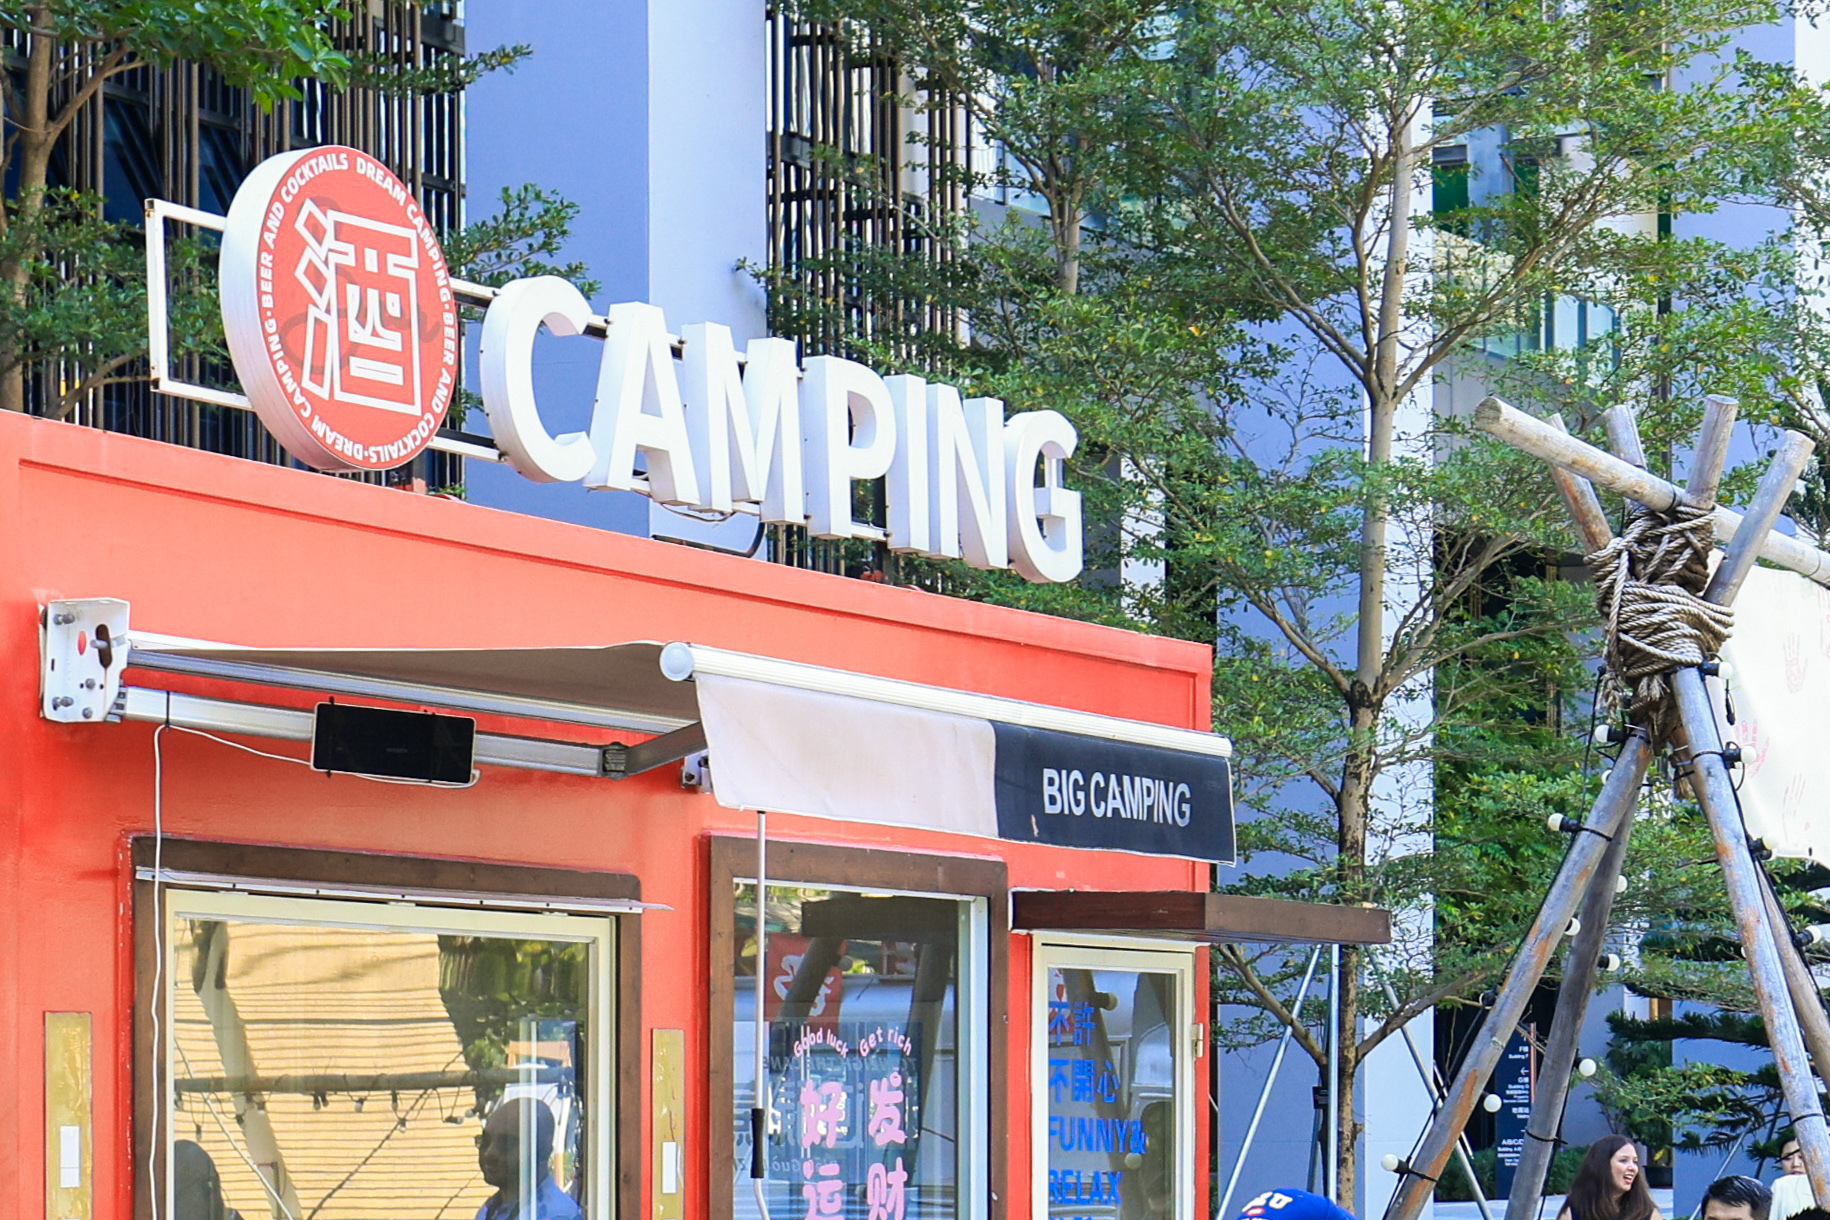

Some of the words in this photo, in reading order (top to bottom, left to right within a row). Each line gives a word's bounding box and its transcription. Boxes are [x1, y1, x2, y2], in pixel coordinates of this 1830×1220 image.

[280, 152, 349, 203] COCKTAILS
[356, 157, 407, 207] DREAM
[263, 203, 286, 248] AND
[480, 275, 1083, 584] CAMPING
[1042, 768, 1086, 816] BIG
[1090, 772, 1192, 827] CAMPING
[793, 1027, 823, 1058] Good
[826, 1028, 849, 1059] luck
[859, 1026, 884, 1057] Get
[887, 1026, 912, 1056] rich
[1048, 1001, 1096, 1046] 不許
[1048, 1059, 1122, 1104] 不開心
[1048, 1169, 1123, 1205] RELAX
